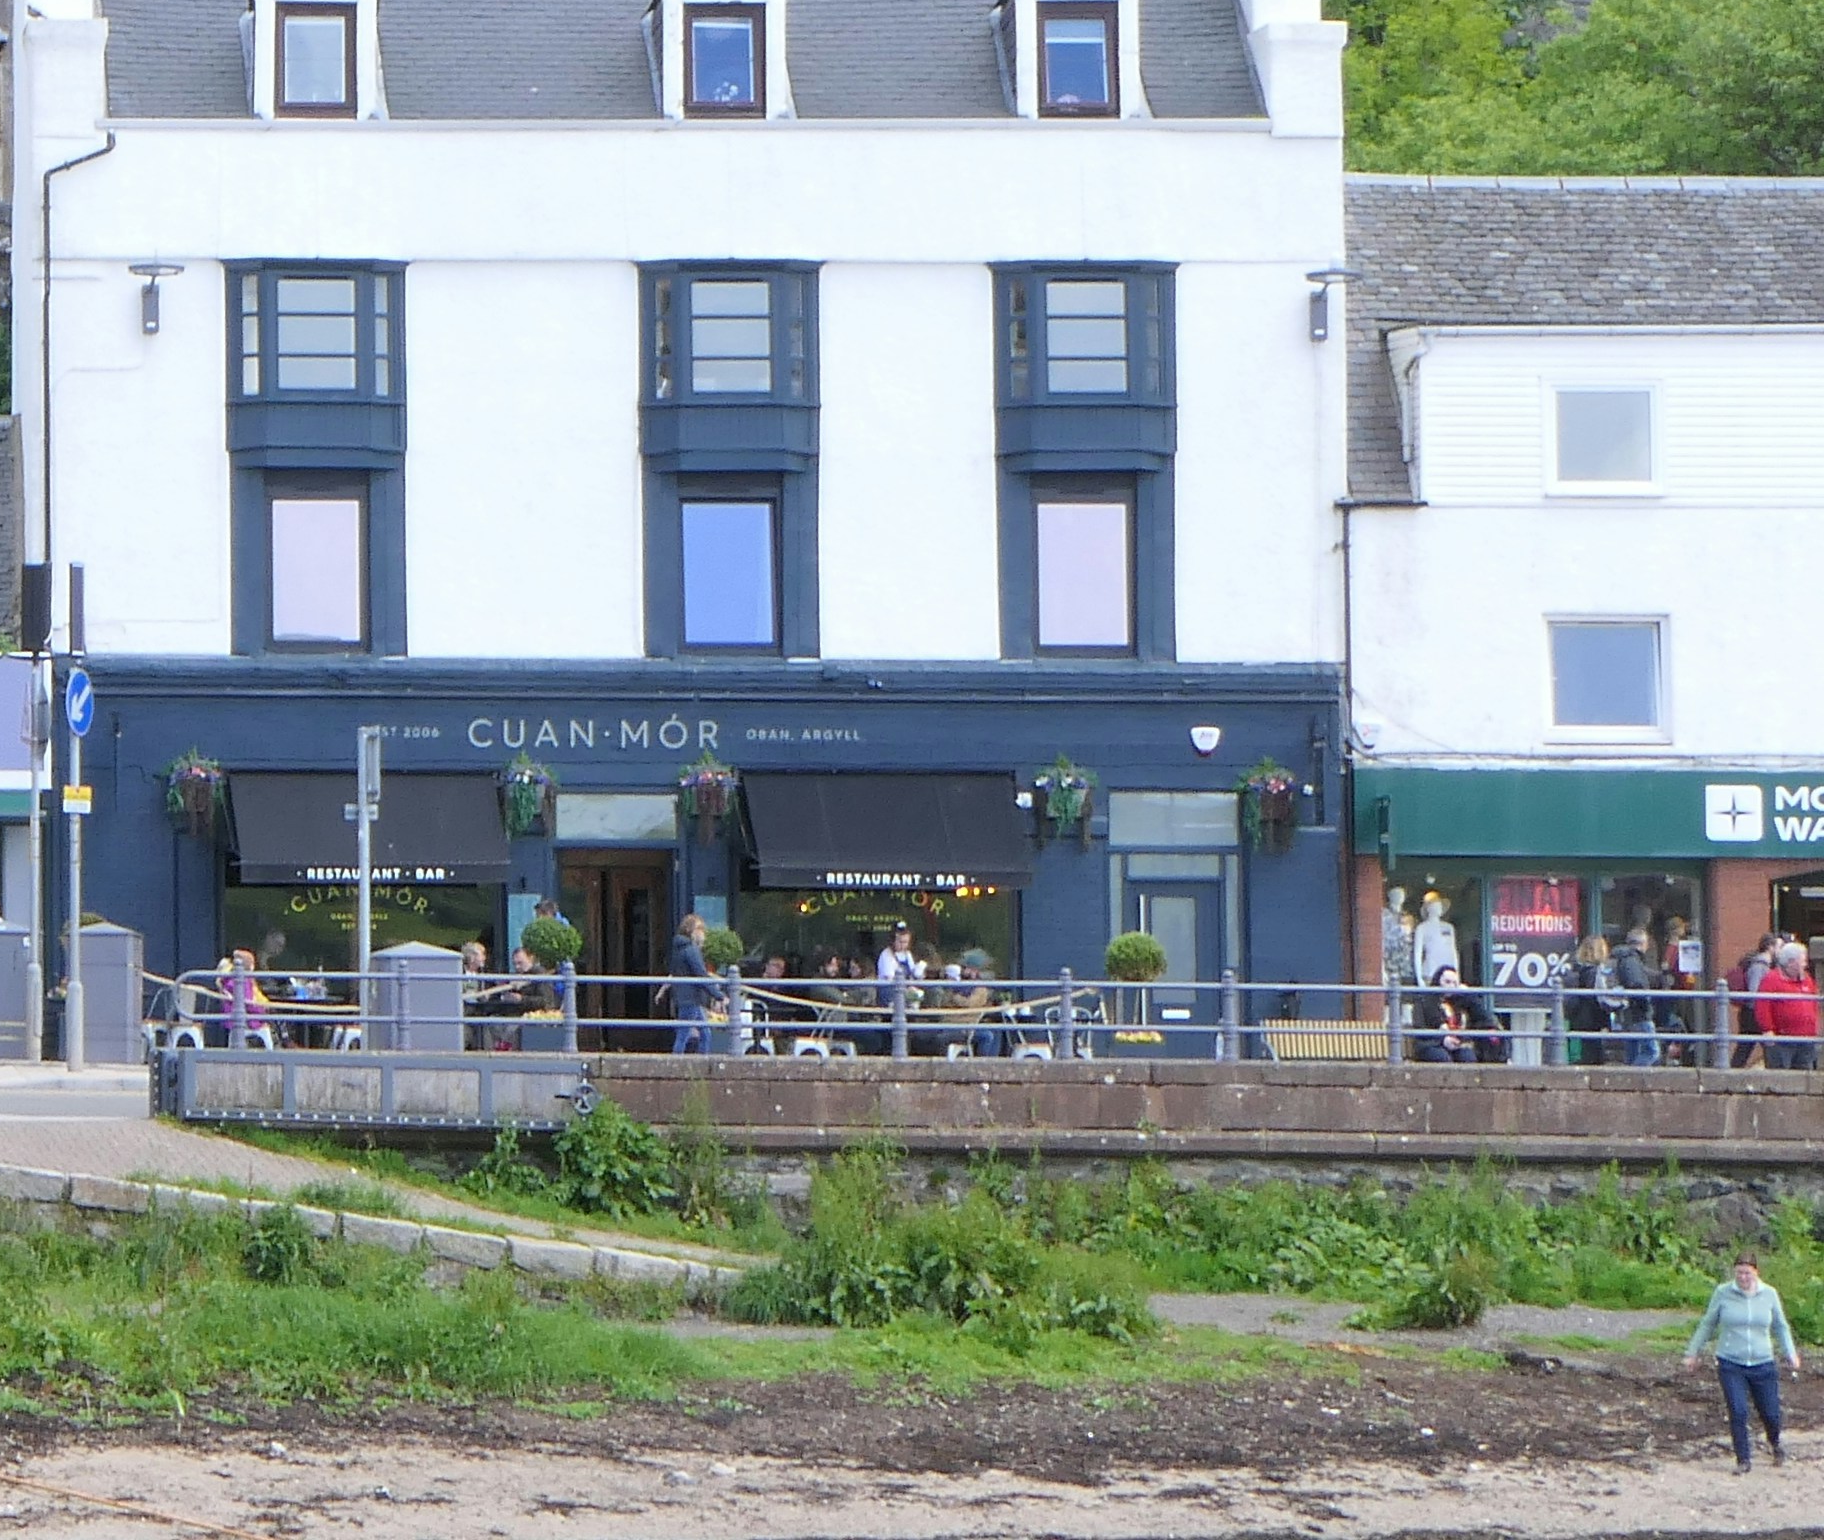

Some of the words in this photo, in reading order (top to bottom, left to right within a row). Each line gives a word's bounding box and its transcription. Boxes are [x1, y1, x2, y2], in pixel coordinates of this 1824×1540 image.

[403, 726, 441, 739] 2006
[801, 728, 861, 741] ARGYLL
[306, 867, 402, 880] RESTAUANT
[415, 867, 446, 880] BAR
[826, 872, 922, 886] RESTAURANT
[935, 874, 966, 887] BAR
[1491, 914, 1573, 932] REDUCTIONS
[1492, 952, 1572, 987] 70%
